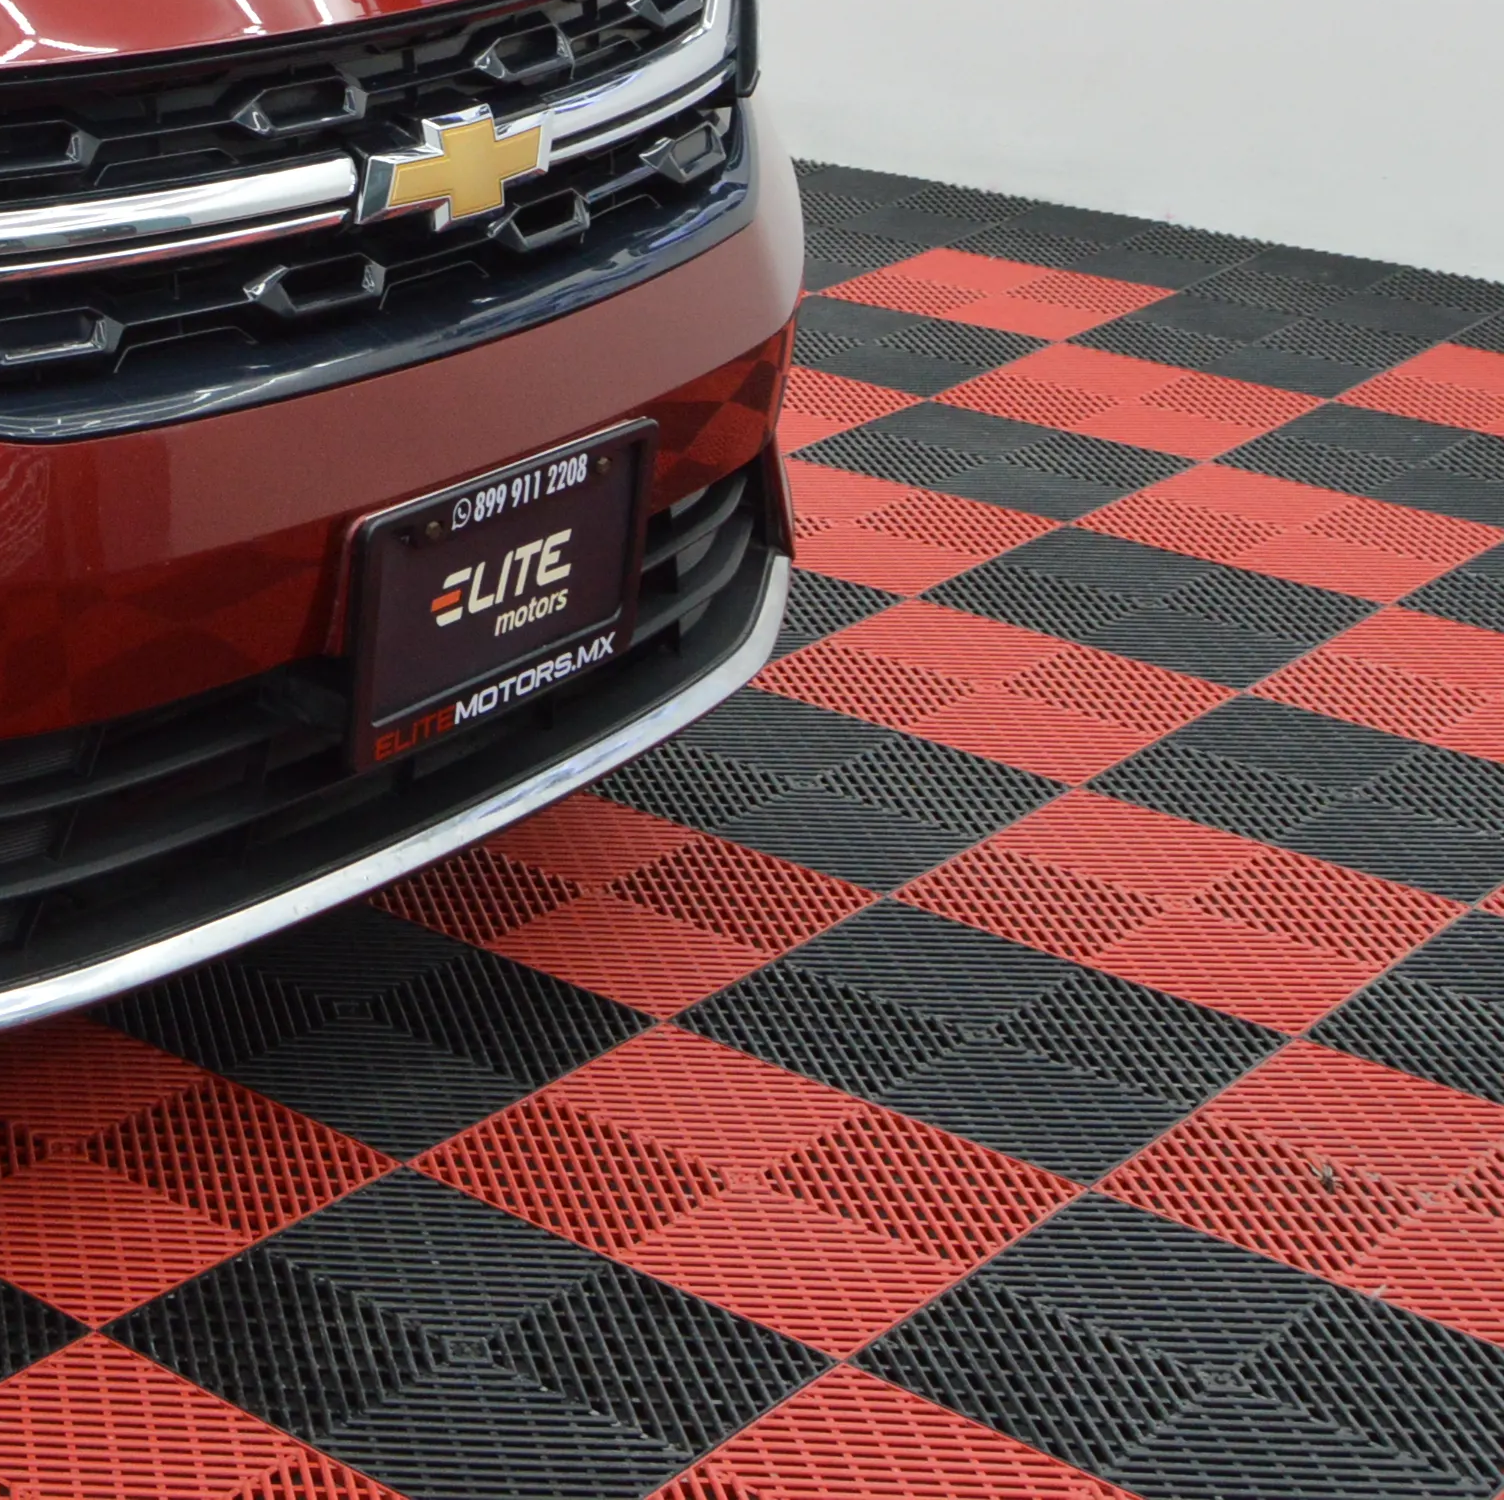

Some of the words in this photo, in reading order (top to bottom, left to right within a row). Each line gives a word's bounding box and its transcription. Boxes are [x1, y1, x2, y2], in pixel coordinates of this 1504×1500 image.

[473, 482, 507, 522] 899
[511, 467, 541, 509] 911
[547, 453, 588, 495] 2208
[430, 528, 572, 627] ELITE
[494, 586, 568, 637] motors
